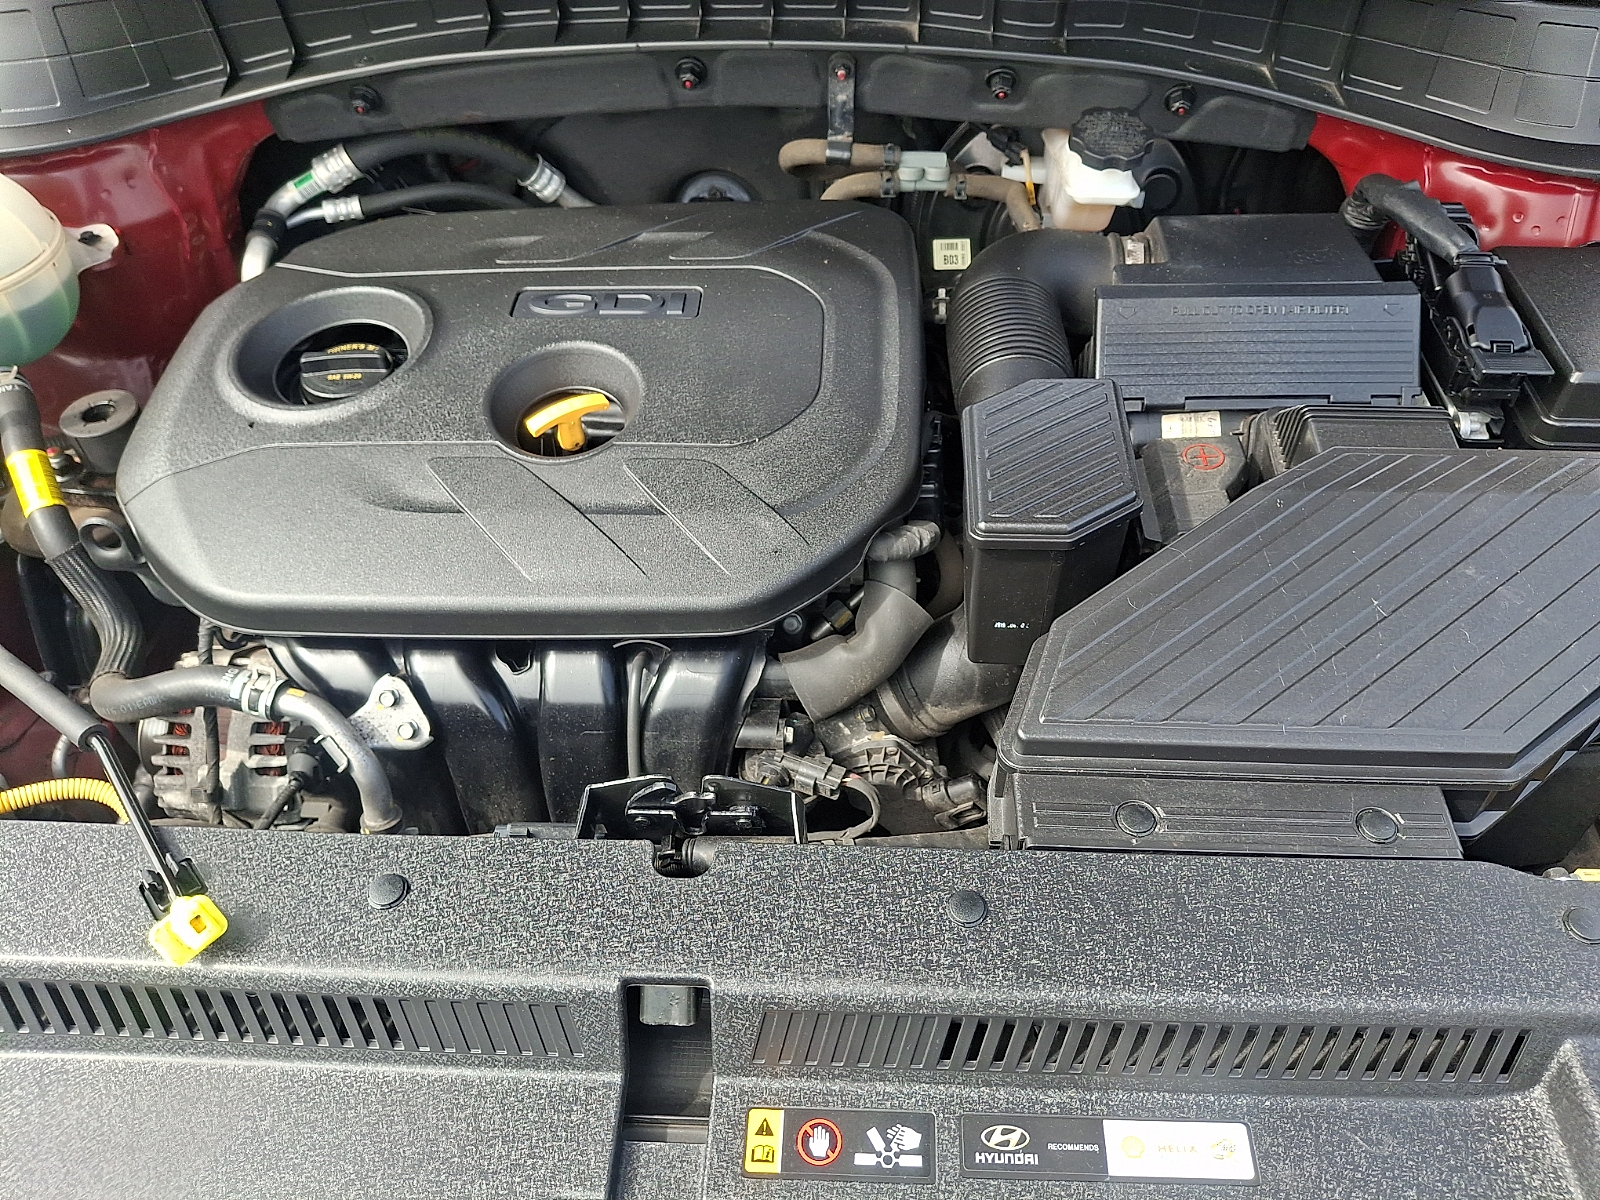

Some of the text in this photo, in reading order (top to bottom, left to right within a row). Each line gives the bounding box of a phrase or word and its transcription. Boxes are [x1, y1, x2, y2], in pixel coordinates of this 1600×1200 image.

[528, 293, 687, 315] GDI
[1171, 304, 1200, 316] PULL
[1202, 304, 1227, 316] OUT
[1229, 304, 1243, 316] TO
[975, 1143, 1198, 1165] HYUNDAI RECOMMENDS HELIX
